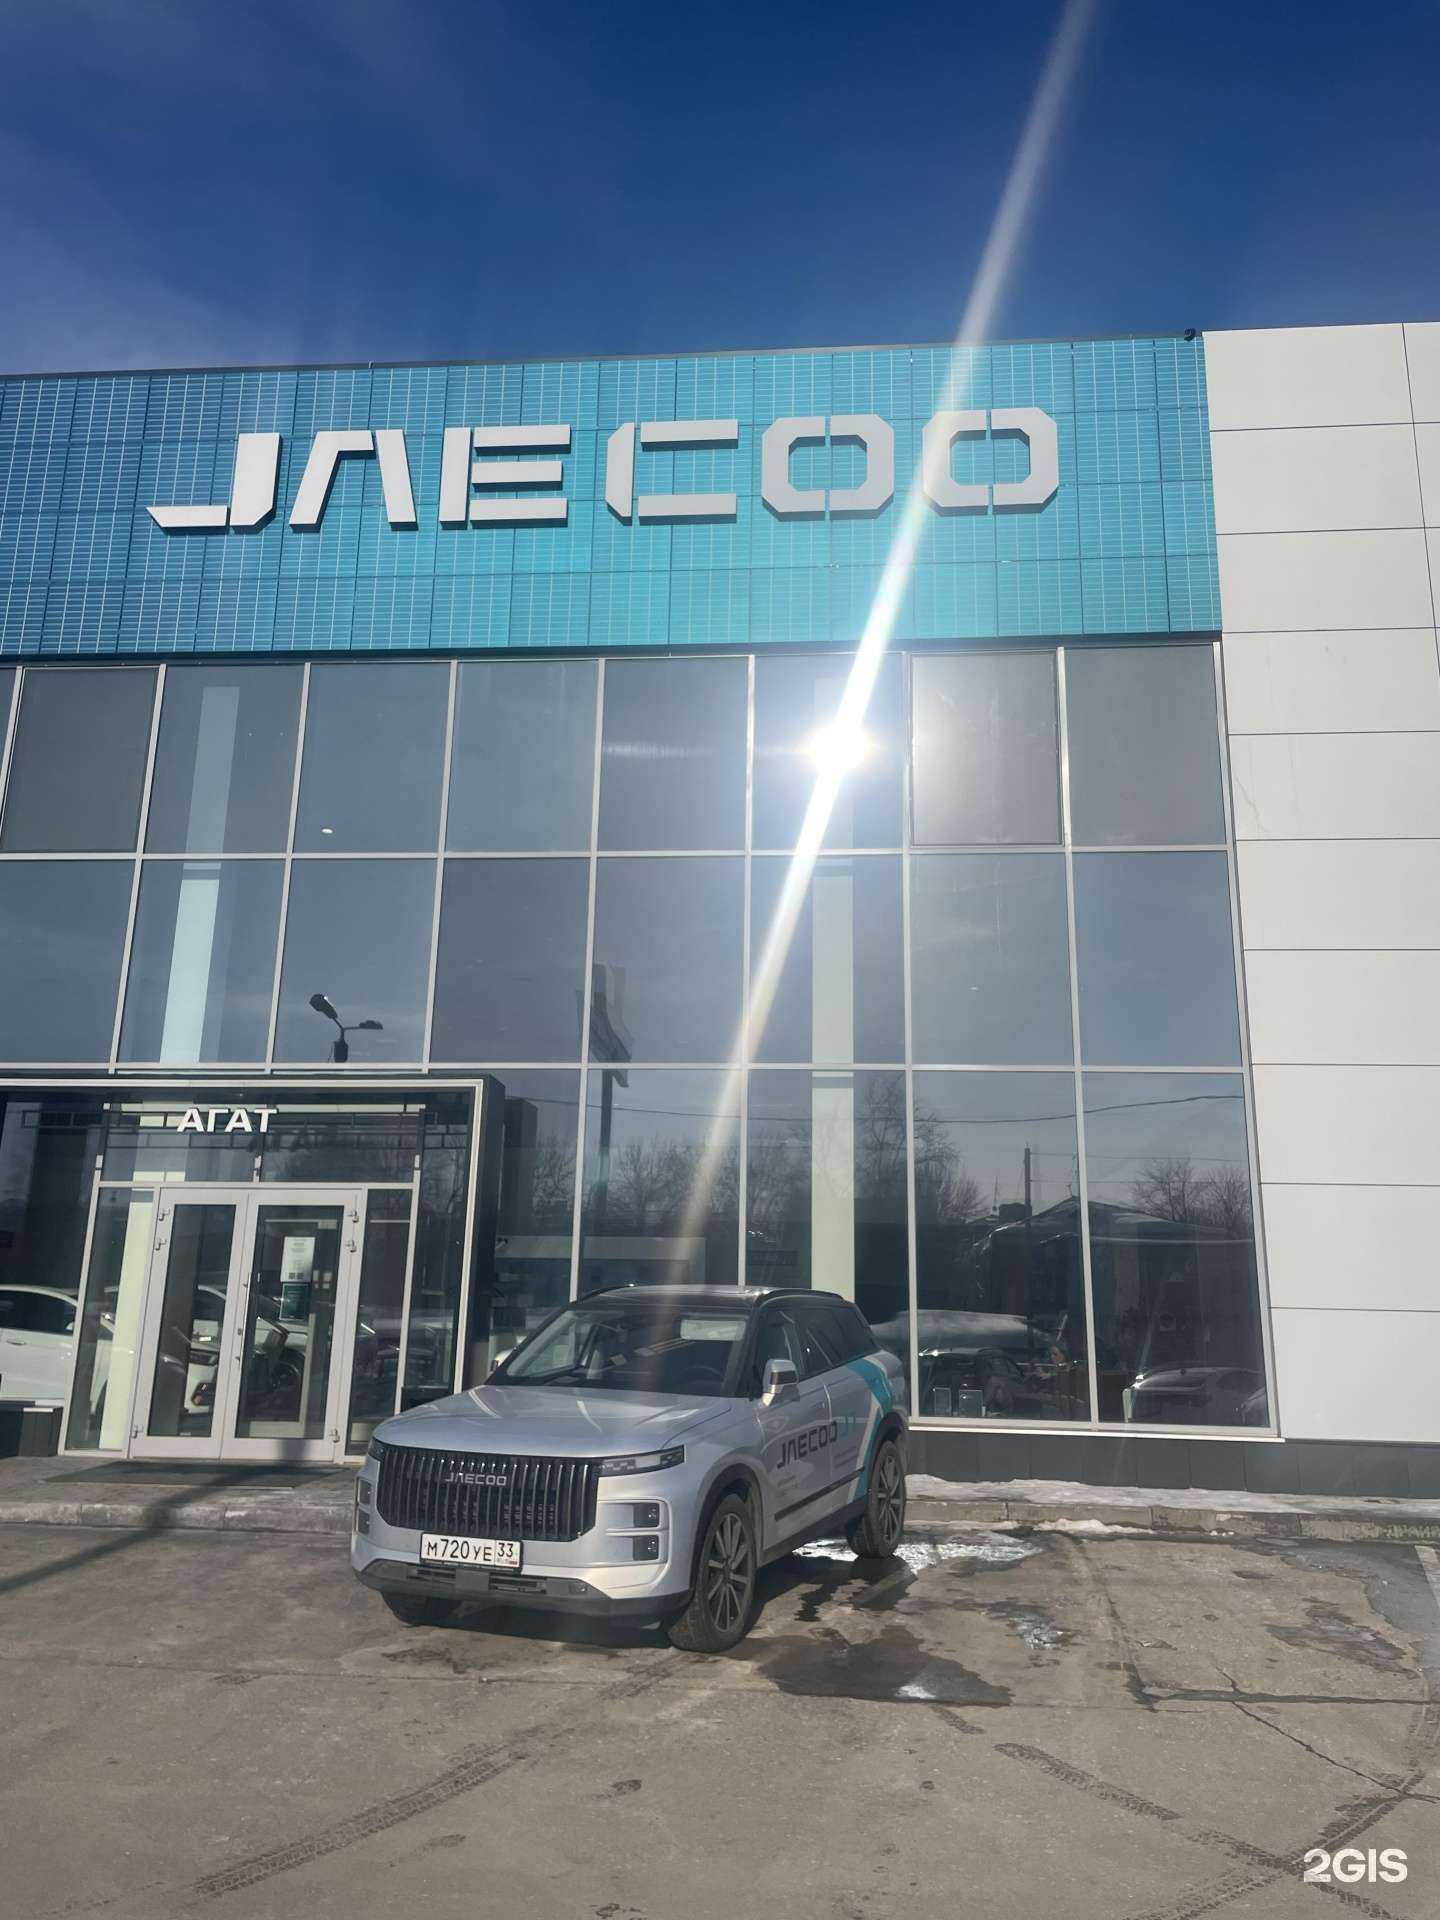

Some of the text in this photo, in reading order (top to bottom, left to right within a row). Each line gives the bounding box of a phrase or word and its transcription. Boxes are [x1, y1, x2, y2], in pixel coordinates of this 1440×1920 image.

[146, 407, 1059, 529] JAECOO
[176, 1107, 277, 1133] АГАТ
[777, 1420, 838, 1469] JAECOO
[445, 1472, 507, 1486] JAECOO
